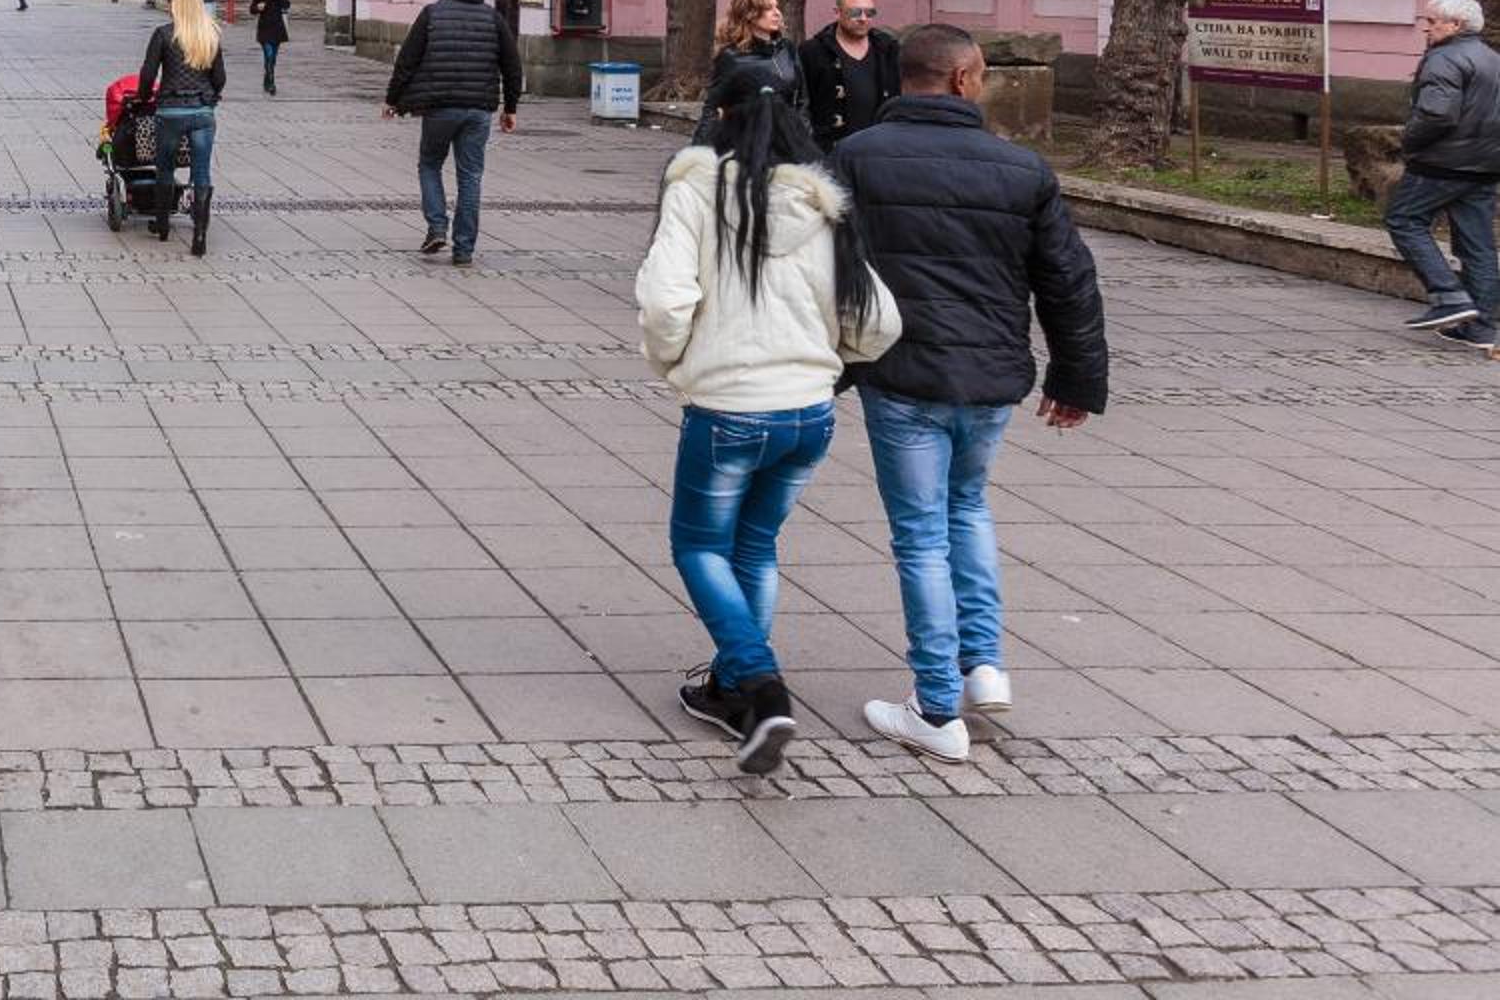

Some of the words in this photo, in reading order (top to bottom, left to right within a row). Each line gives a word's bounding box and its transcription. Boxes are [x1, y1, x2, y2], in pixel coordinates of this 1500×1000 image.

[1195, 23, 1232, 34] СТЕНА
[1237, 25, 1254, 35] НА
[1259, 26, 1316, 39] БУКВИТЕ
[1201, 47, 1235, 58] WALL
[1238, 49, 1254, 59] OF
[1259, 51, 1309, 63] LETTERS
